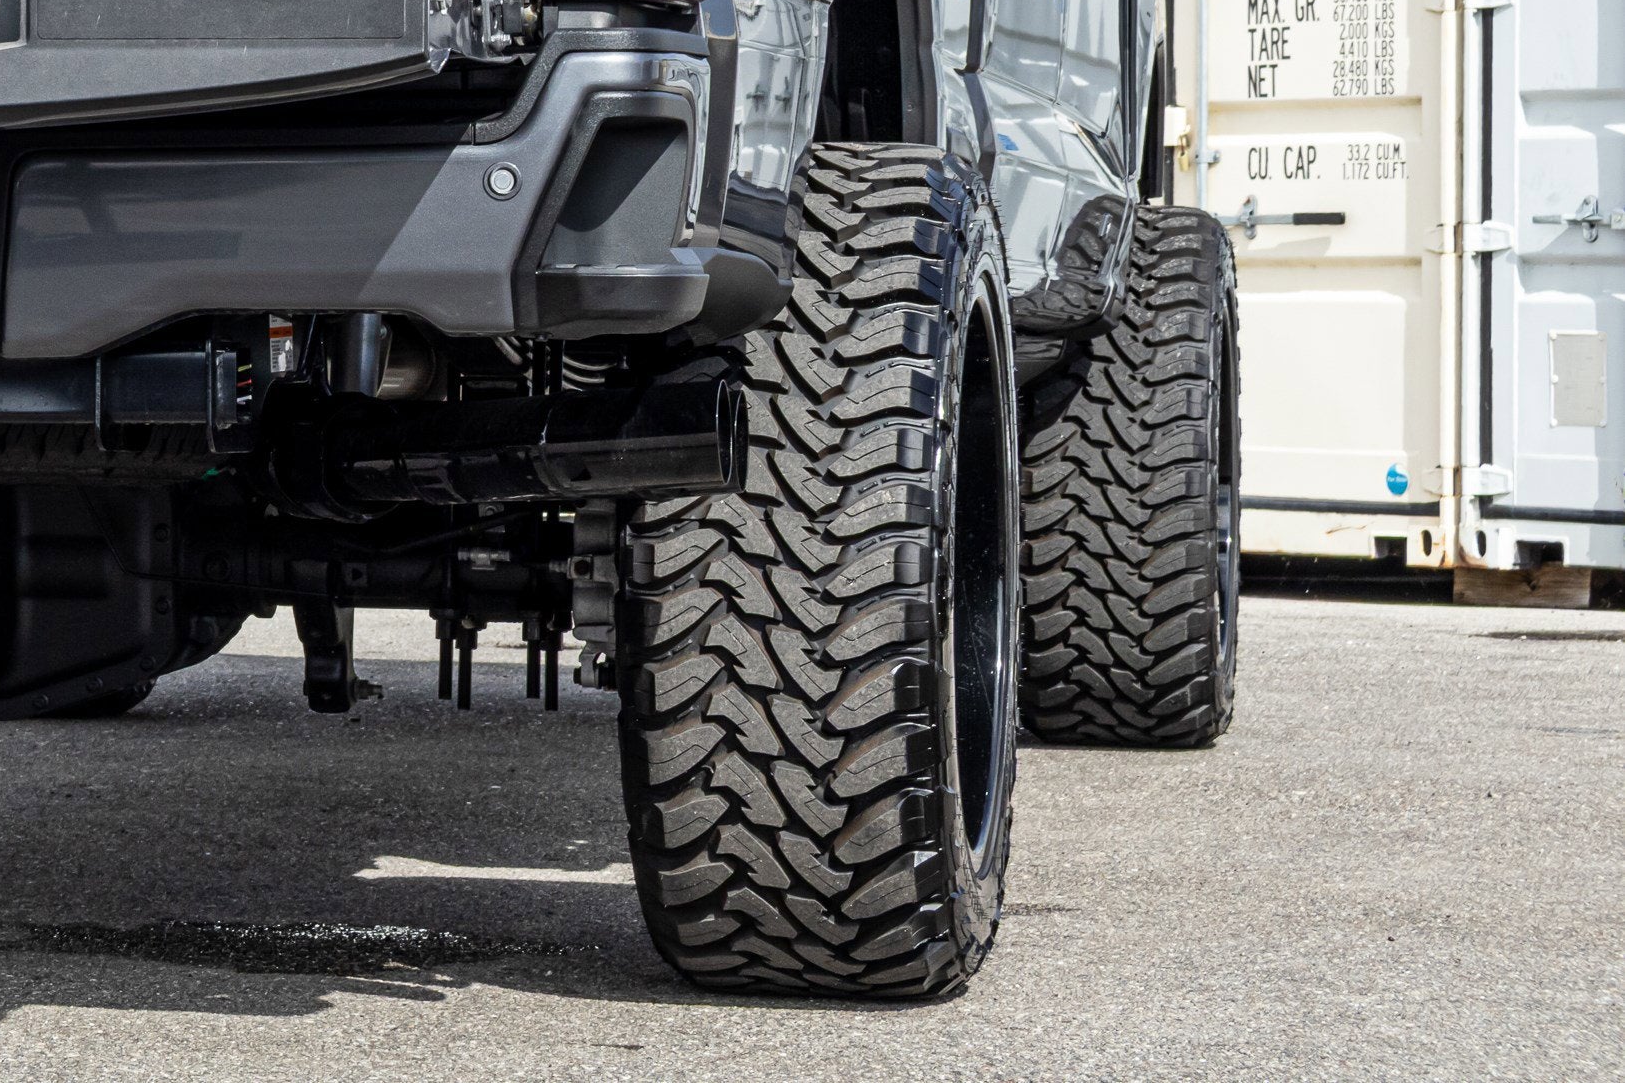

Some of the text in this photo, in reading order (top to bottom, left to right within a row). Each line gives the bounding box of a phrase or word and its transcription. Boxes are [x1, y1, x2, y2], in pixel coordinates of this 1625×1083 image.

[1333, 2, 1395, 22] 67.200 LBS
[1339, 21, 1395, 40] 2.000 KGS
[1247, 26, 1291, 61] TARE
[1339, 40, 1394, 58] 4.410 LBS
[1333, 59, 1394, 78] 28.480 KGS
[1248, 64, 1278, 98] NET
[1333, 77, 1394, 96] 62.790 LBS
[1347, 143, 1403, 161] 33.2 CU.M.
[1248, 145, 1321, 180] CU. CAP.
[1342, 161, 1410, 180] 1.172 CU.FT.
